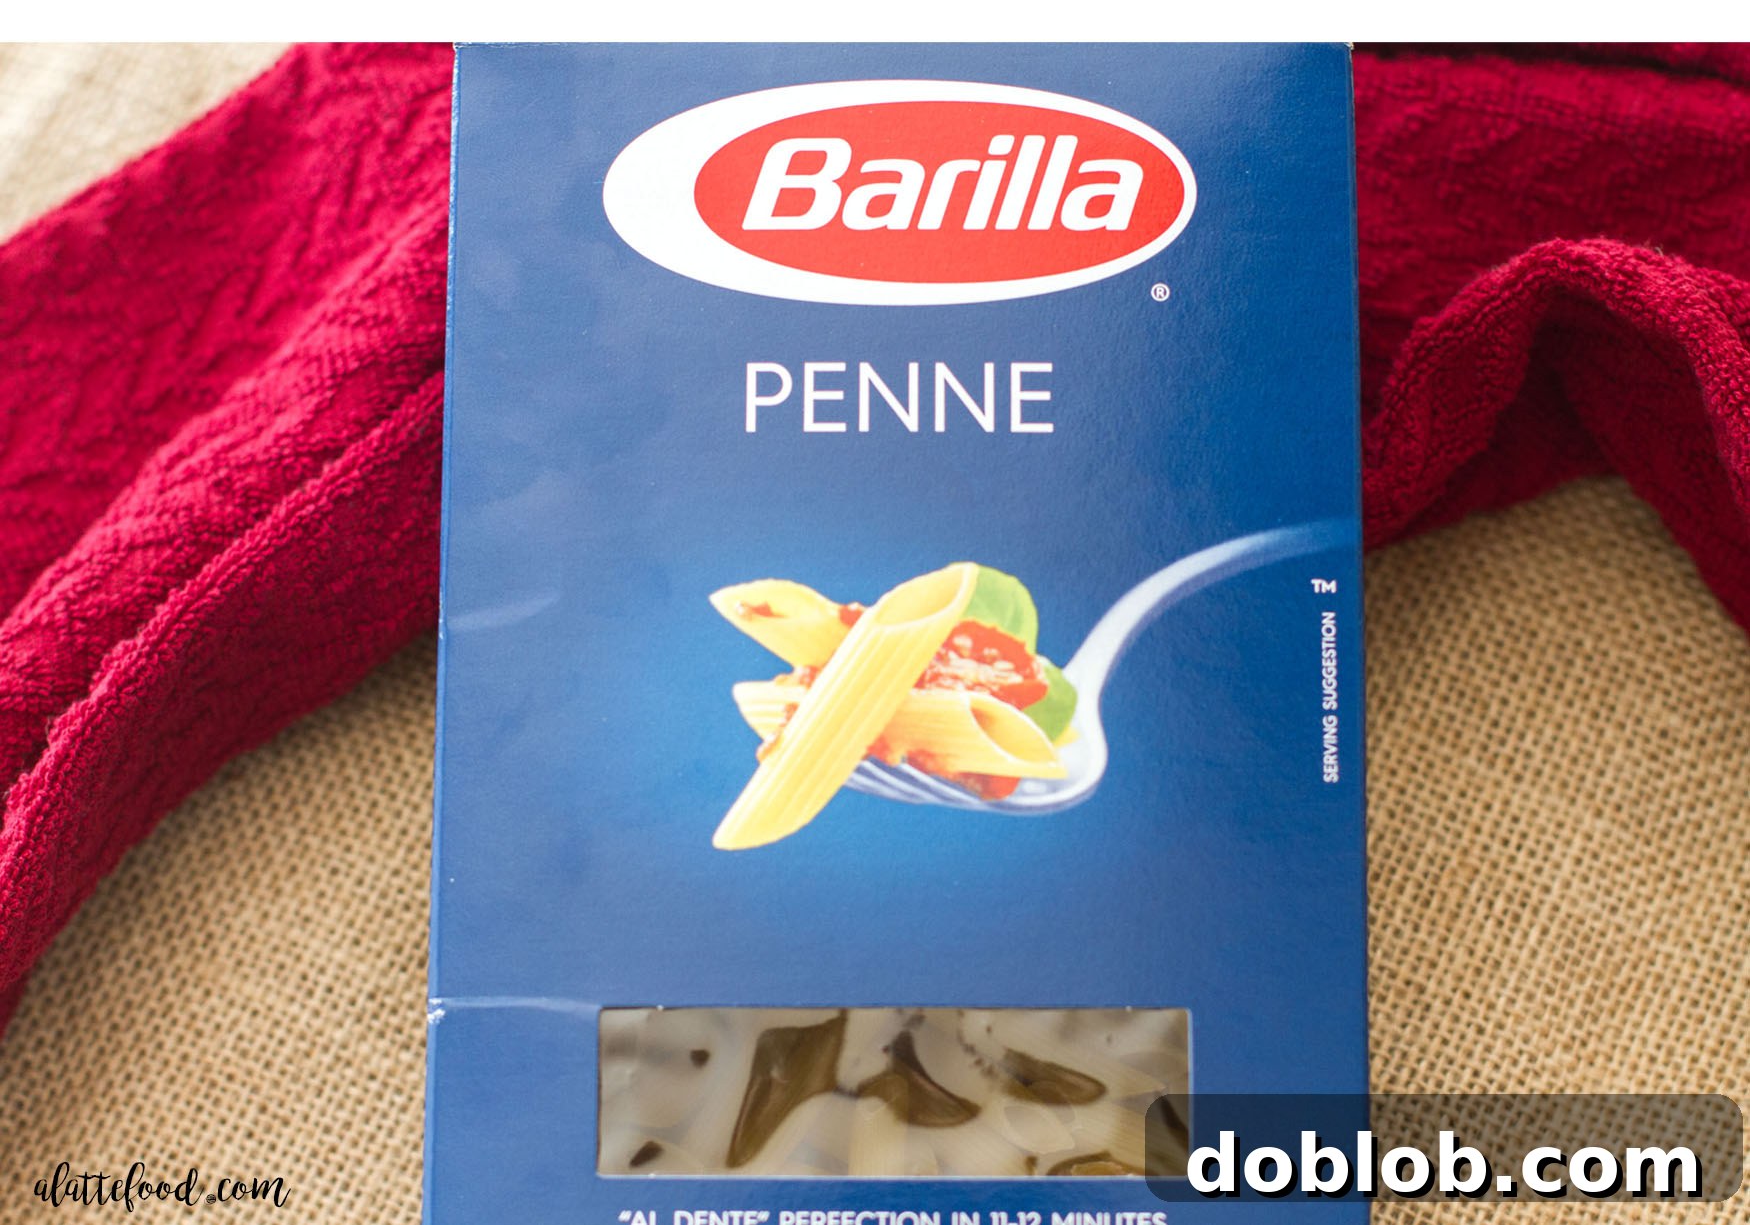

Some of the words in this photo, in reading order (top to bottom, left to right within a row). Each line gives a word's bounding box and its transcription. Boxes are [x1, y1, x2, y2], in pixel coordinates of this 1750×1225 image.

[742, 135, 1143, 231] Barilla
[745, 361, 1054, 433] PENNE
[1321, 611, 1338, 710] SUGGESTION
[1322, 715, 1339, 783] SERVING
